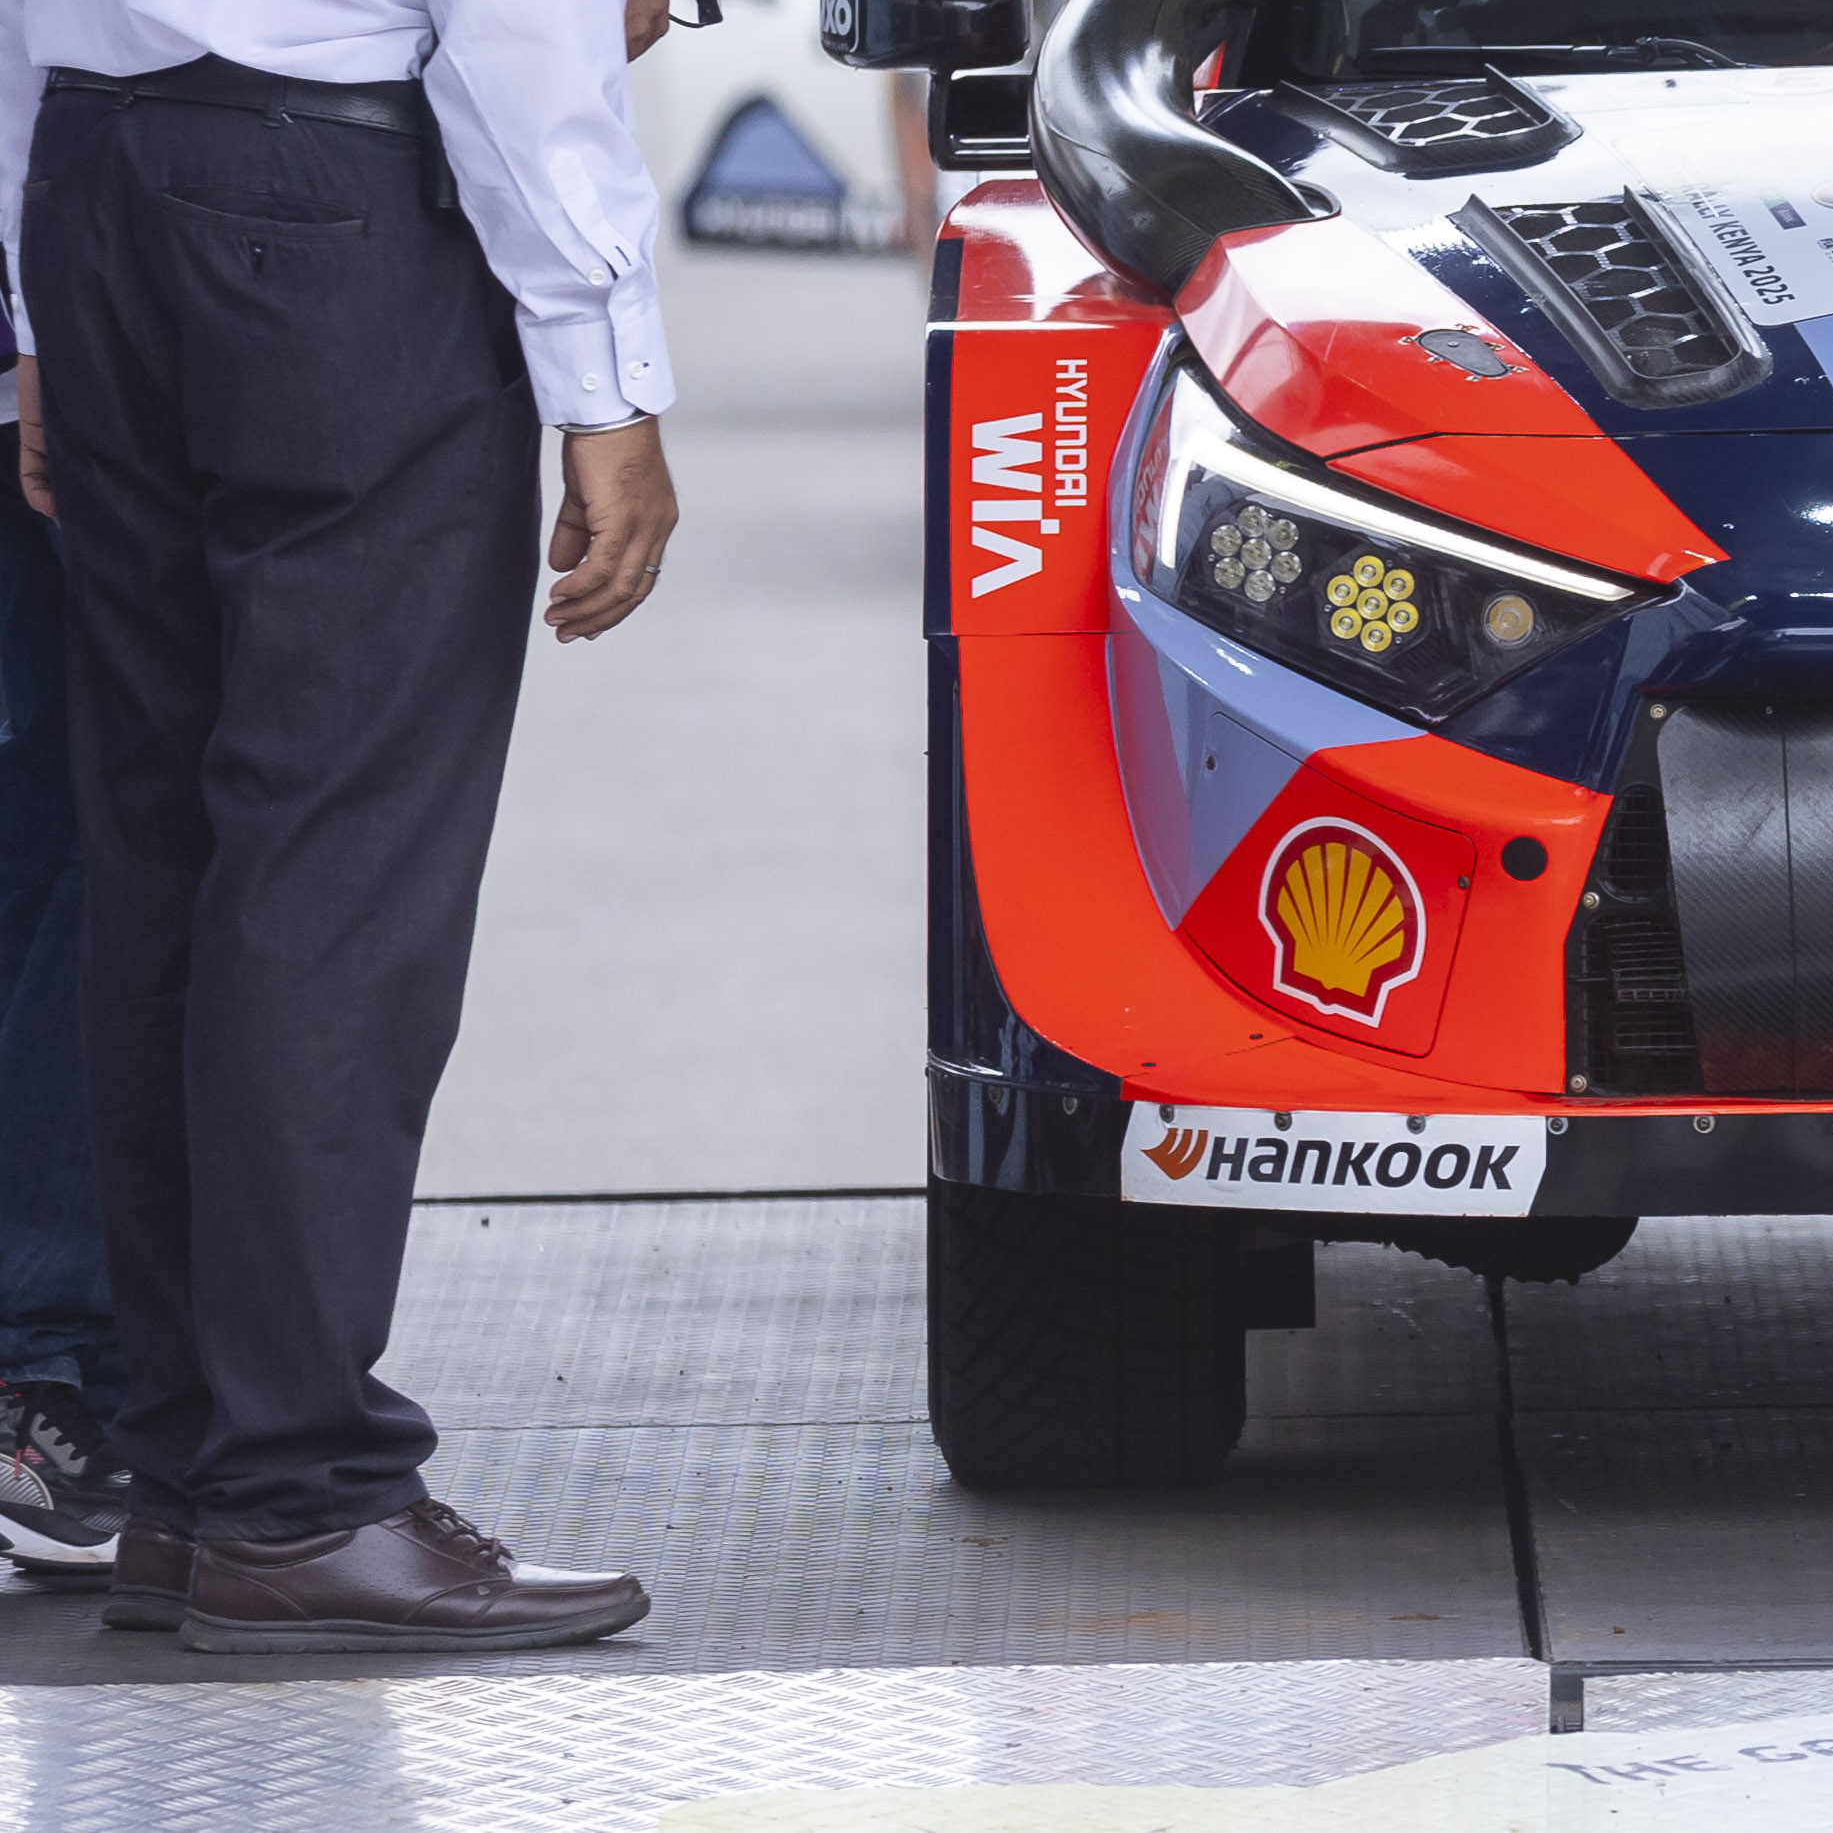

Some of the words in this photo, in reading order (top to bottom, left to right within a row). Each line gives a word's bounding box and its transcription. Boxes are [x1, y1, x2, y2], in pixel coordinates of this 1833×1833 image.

[1709, 214, 1767, 268] KENYA
[1742, 264, 1797, 306] 2025
[1054, 358, 1088, 507] HYUNDAI
[1545, 1751, 1735, 1787] THE
